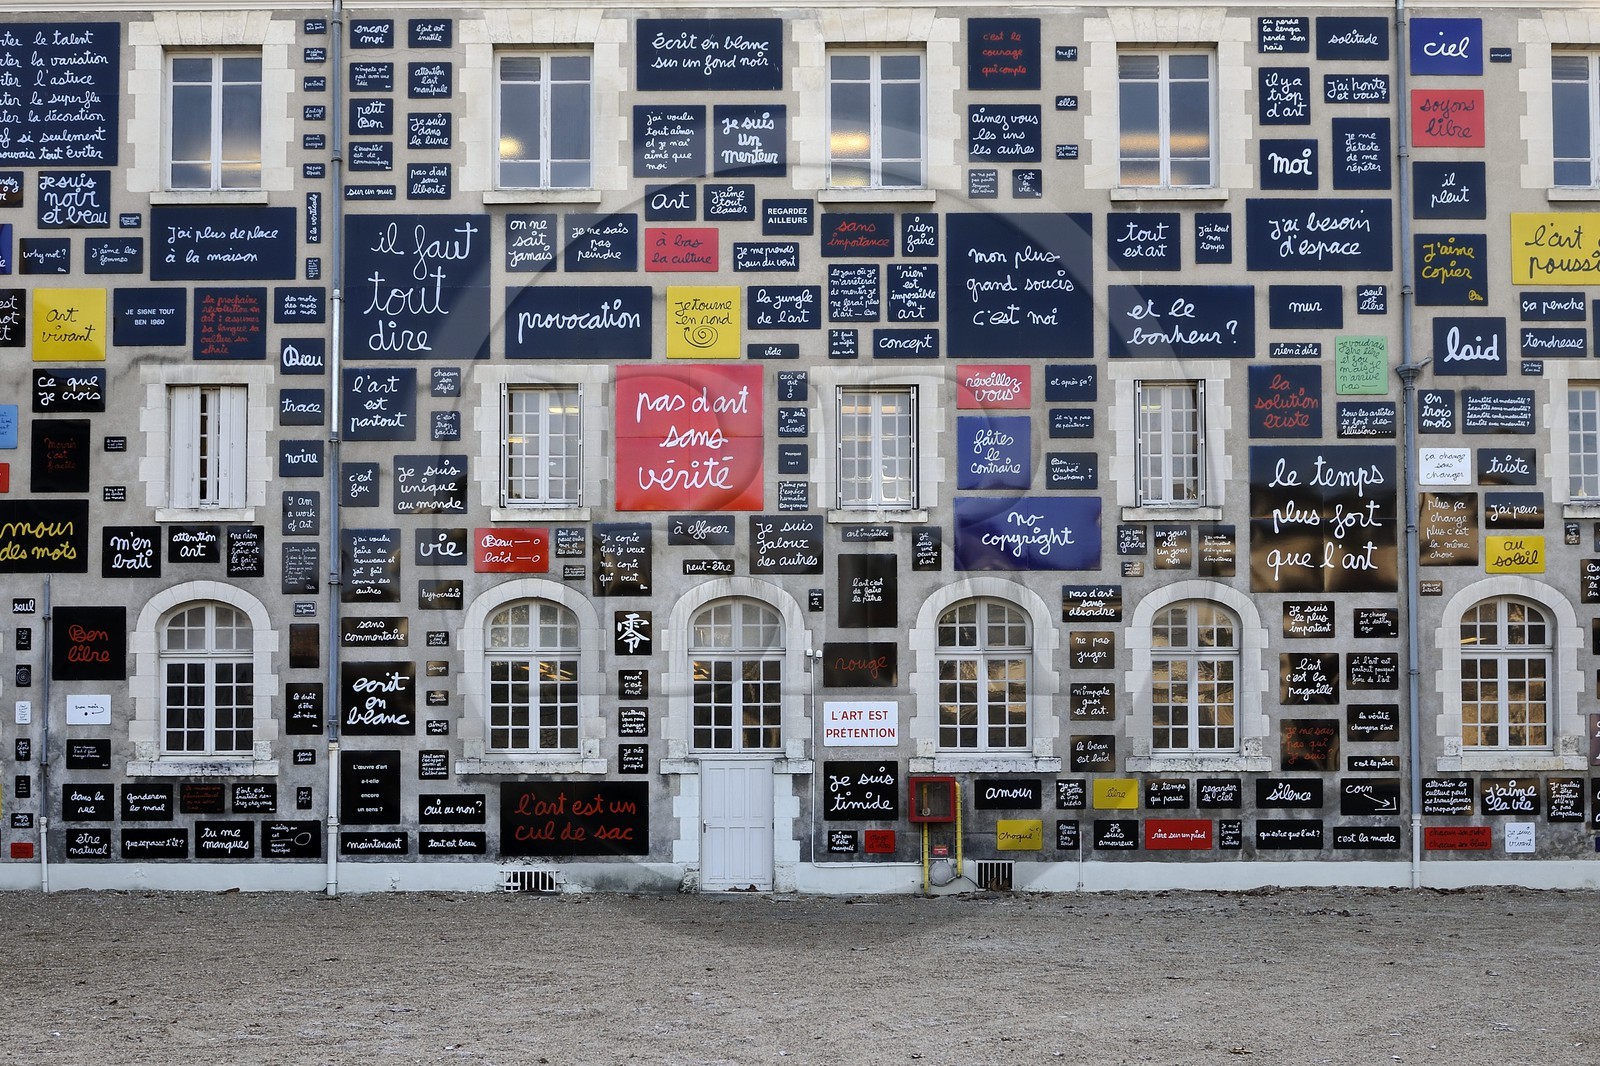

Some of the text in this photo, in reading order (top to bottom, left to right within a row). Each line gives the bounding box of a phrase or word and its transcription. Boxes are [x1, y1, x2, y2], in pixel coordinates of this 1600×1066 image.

[652, 32, 768, 50] écrit en blanc
[1328, 29, 1378, 45] solitude
[1424, 32, 1469, 58] ciel
[31, 50, 108, 66] la variation
[651, 51, 768, 75] sur un fond noir
[34, 70, 95, 86] l'astuce
[357, 101, 385, 120] petit
[1058, 98, 1076, 107] elle
[1420, 99, 1474, 119] soyons
[28, 108, 105, 122] la décoration
[358, 117, 383, 129] Ben
[1425, 118, 1472, 138] libre
[1268, 148, 1312, 175] moi
[411, 170, 426, 178] pas
[1442, 172, 1455, 187] il
[411, 183, 446, 194] liberté
[1431, 186, 1469, 208] pleut
[836, 221, 875, 232] sans
[1307, 210, 1370, 232] besoin
[196, 227, 226, 242] plus
[247, 226, 278, 240] place
[656, 232, 703, 248] à bas
[827, 232, 889, 250] importance
[166, 248, 257, 263] à la maison
[371, 222, 478, 285] il faut
[1280, 235, 1361, 260] d'espace
[652, 252, 712, 264] la culture
[968, 246, 1060, 269] mon plus
[1422, 260, 1472, 284] copier
[364, 262, 448, 315] tout
[967, 270, 1074, 302] grand soucis
[973, 304, 1058, 325] c'est moi
[1127, 298, 1195, 319] et le
[1289, 302, 1322, 312] mur
[518, 299, 640, 344] provocation
[43, 325, 95, 342] vivant
[369, 320, 432, 351] dire
[1127, 325, 1222, 344] bonheur
[1523, 333, 1583, 348] tendresse
[765, 347, 781, 355] vide
[880, 334, 932, 353] concept
[1444, 326, 1499, 362] laid
[352, 375, 399, 393] l'art
[965, 372, 1022, 394] réveillez
[1269, 374, 1290, 390] la
[364, 397, 388, 410] est
[976, 389, 1013, 402] vous
[1255, 388, 1318, 410] solution
[1424, 393, 1441, 404] en
[282, 398, 321, 413] trace
[637, 393, 685, 423] pas
[1422, 404, 1451, 417] trois
[351, 412, 407, 432] partout
[1264, 411, 1309, 428] existe
[1423, 418, 1451, 428] mots
[659, 426, 728, 449] sans
[974, 430, 1013, 454] faites
[985, 448, 1000, 461] le
[971, 458, 1020, 474] contraire
[1486, 455, 1529, 474] triste
[639, 456, 733, 491] vérité
[1269, 456, 1384, 497] le temps
[1008, 512, 1044, 526] no
[1273, 500, 1382, 539] plus fort
[674, 520, 729, 540] à effacer
[110, 532, 151, 551] m'en
[420, 533, 463, 556] vie
[982, 527, 1074, 558] copyright
[1504, 541, 1525, 551] au
[482, 552, 513, 563] laid
[1267, 541, 1378, 581] que l'art
[1493, 550, 1538, 567] soleil
[685, 560, 731, 574] peut-être
[422, 588, 460, 601] hypocrisie
[13, 599, 35, 612] seul
[69, 625, 108, 642] Ben
[345, 629, 405, 642] commentaire
[618, 613, 650, 653] 零
[68, 645, 110, 662] libre
[835, 654, 889, 679] rouge
[365, 697, 386, 710] en
[347, 708, 410, 725] blanc
[832, 711, 888, 720] L'ART EST
[827, 728, 895, 738] PRÉTENTION
[858, 766, 894, 784] suis
[986, 788, 1031, 799] amour
[1266, 783, 1311, 801] silence
[1346, 785, 1372, 793] coin
[515, 792, 636, 816] l'art est un
[830, 791, 893, 811] timide
[1491, 794, 1534, 811] la vie
[201, 828, 240, 838] tu me
[515, 821, 632, 841] cul de sac
[70, 844, 107, 854] naturel
[203, 840, 249, 852] manques
[347, 838, 402, 849] maintenant
